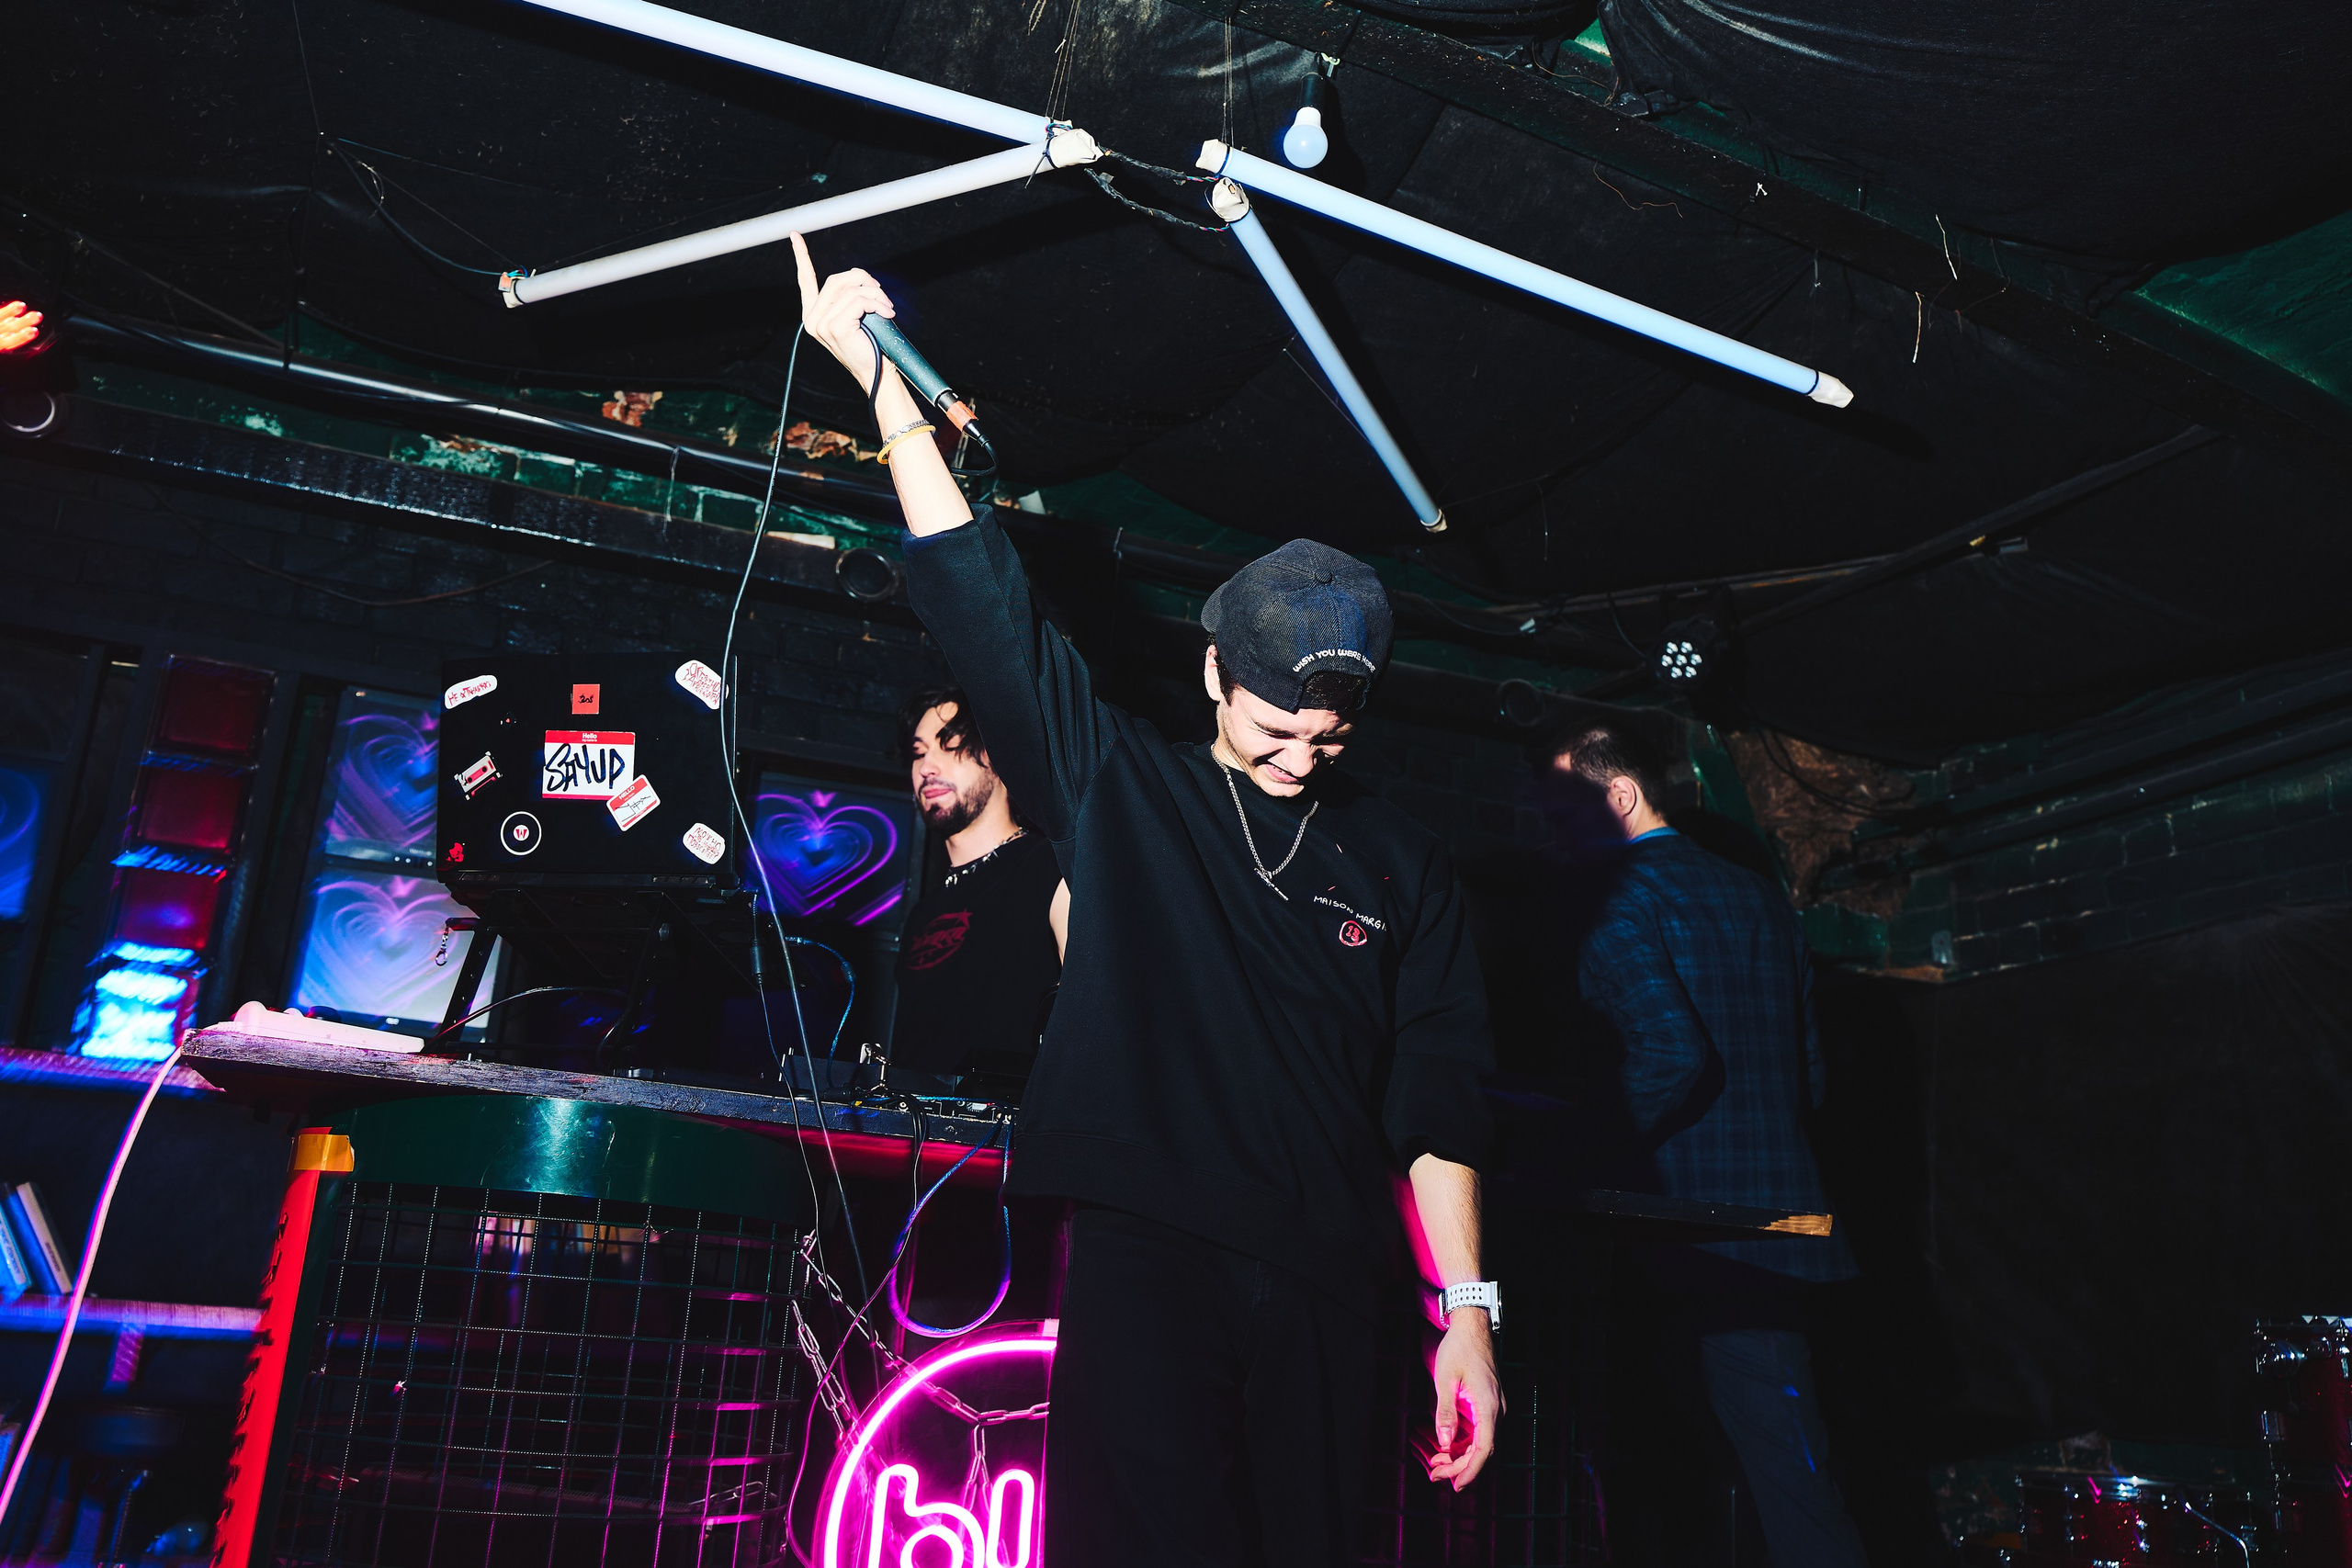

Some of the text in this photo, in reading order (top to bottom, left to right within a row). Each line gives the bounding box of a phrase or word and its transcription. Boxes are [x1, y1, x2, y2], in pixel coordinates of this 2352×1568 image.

[1292, 653, 1316, 672] WISH
[1316, 649, 1336, 660] YOU
[1337, 649, 1362, 661] WERE
[618, 785, 636, 800] HELLO
[1313, 895, 1354, 914] MAISON
